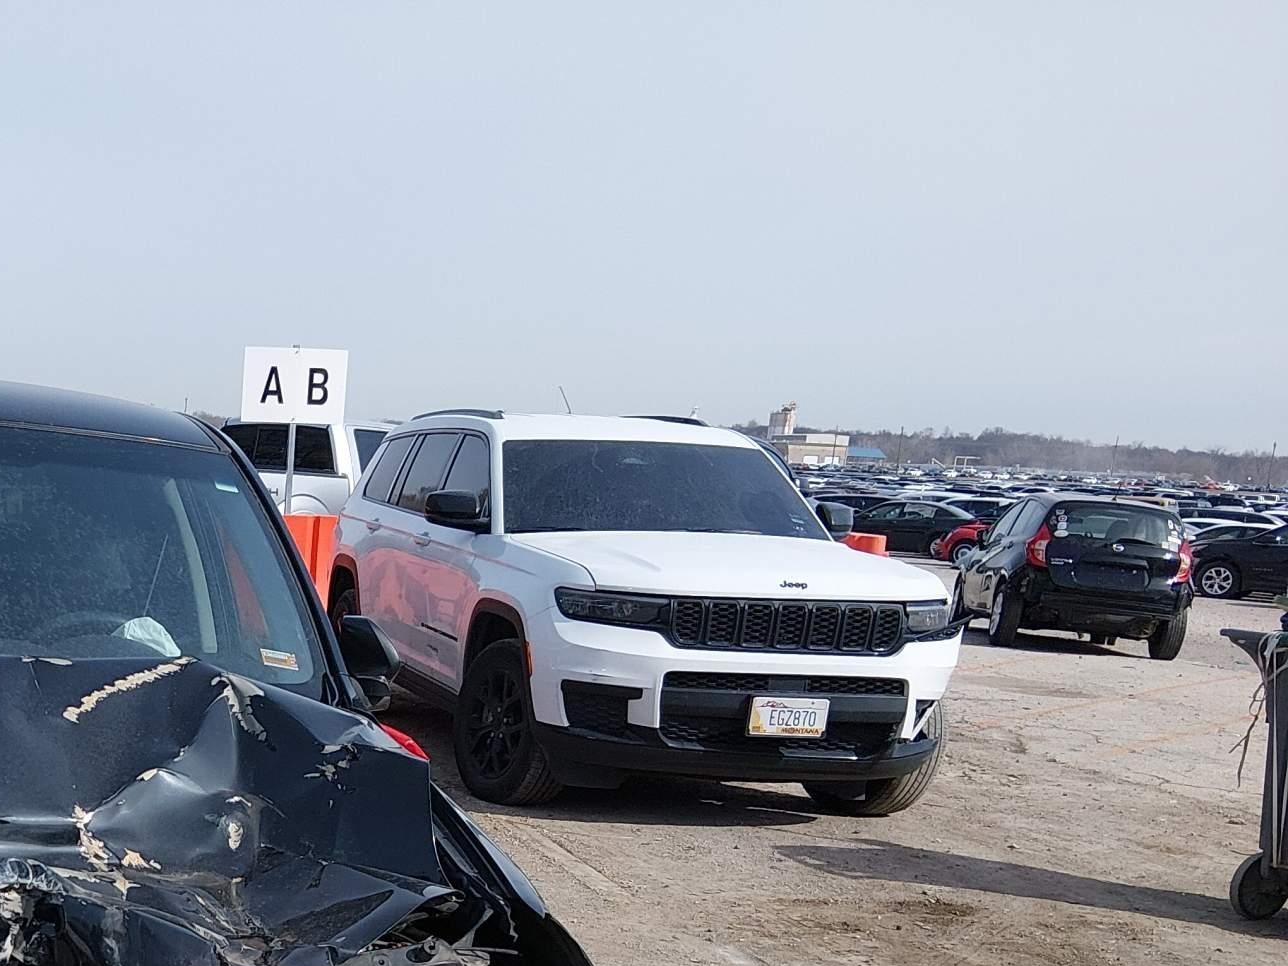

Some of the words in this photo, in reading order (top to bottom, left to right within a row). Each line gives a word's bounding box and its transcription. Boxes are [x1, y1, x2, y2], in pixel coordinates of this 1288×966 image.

[260, 366, 284, 404] A
[307, 367, 329, 406] B
[779, 580, 808, 590] Jeep
[769, 709, 817, 727] EGZ870
